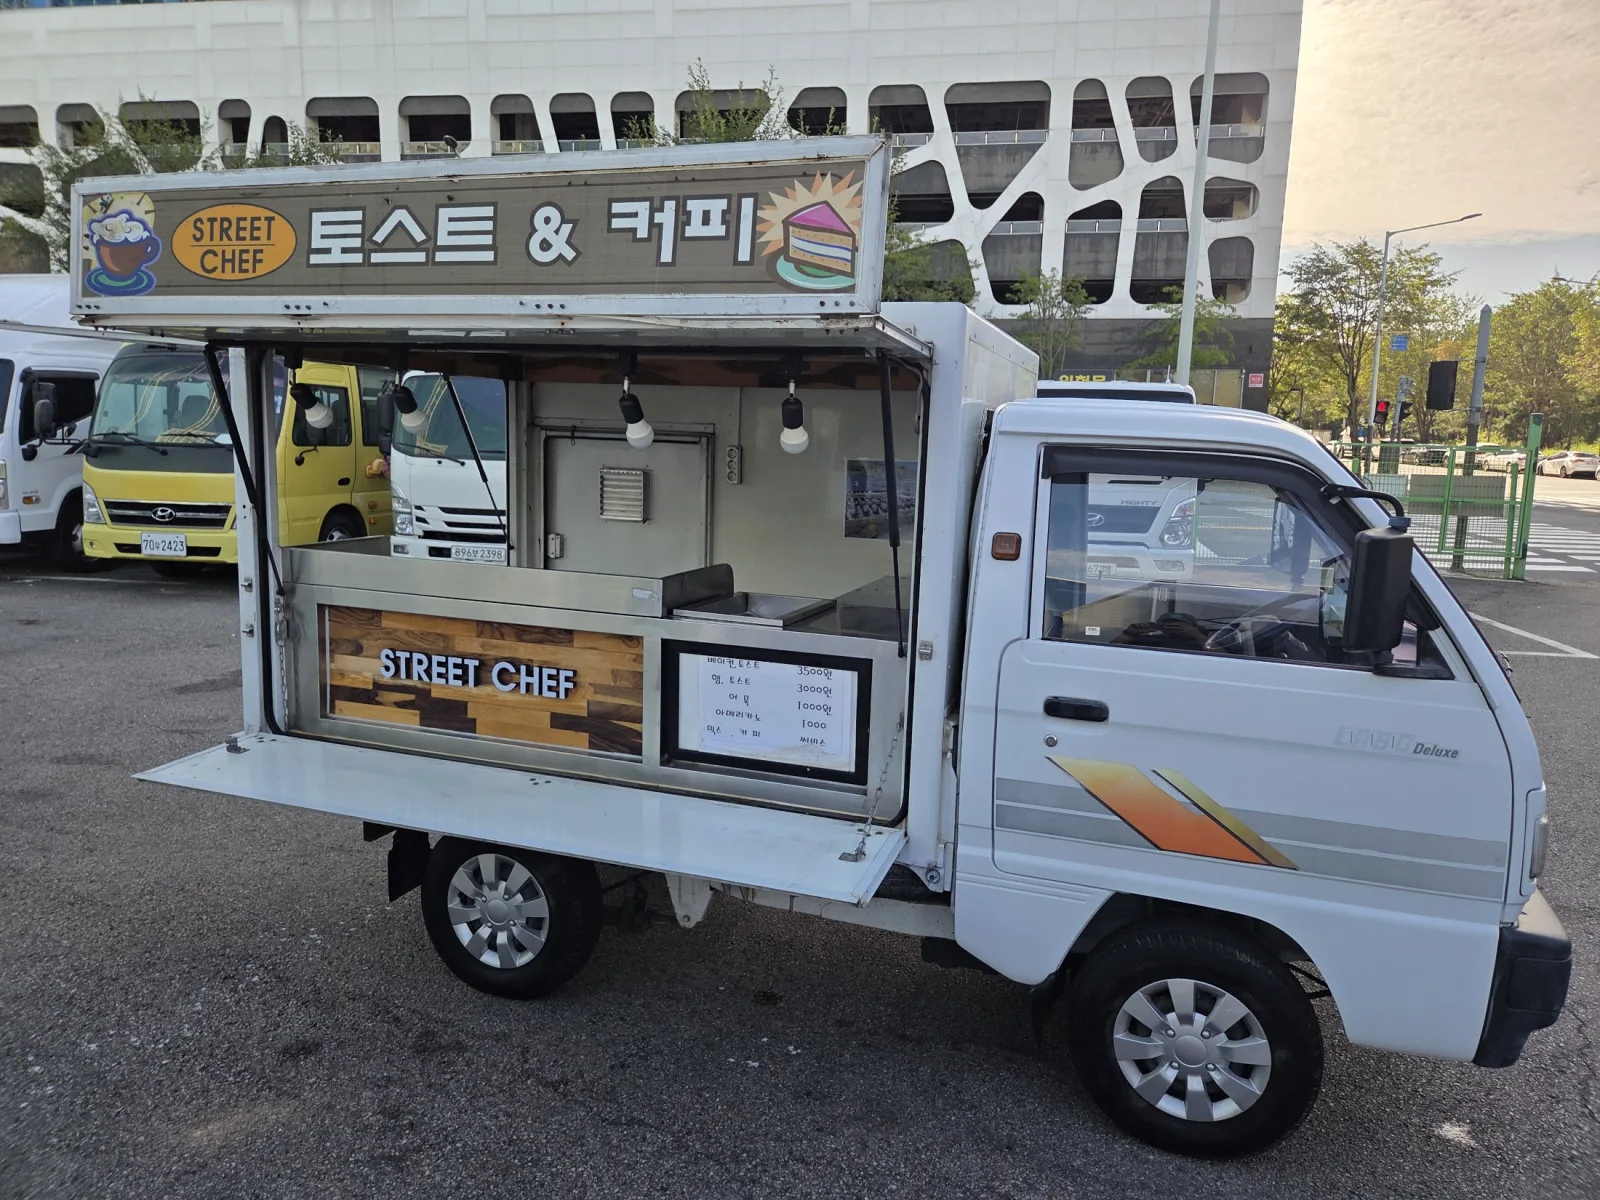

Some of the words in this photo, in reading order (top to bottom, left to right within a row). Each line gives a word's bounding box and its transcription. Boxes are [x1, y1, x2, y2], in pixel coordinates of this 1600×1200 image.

[192, 215, 276, 243] STREET
[308, 205, 496, 265] 토스트
[528, 205, 578, 263] &
[610, 197, 756, 263] 커피
[199, 248, 265, 275] CHEF
[142, 539, 185, 552] 70우2423
[454, 547, 503, 560] 896보2398
[380, 648, 481, 689] STREET
[491, 660, 576, 700] CHEF
[797, 666, 833, 681] 3500원
[729, 676, 751, 686] 토스트
[796, 683, 833, 699] 3000원
[715, 708, 762, 722] 아메리카노
[802, 719, 827, 730] 1000
[797, 701, 833, 716] 1000원
[1412, 741, 1460, 759] Deluxe
